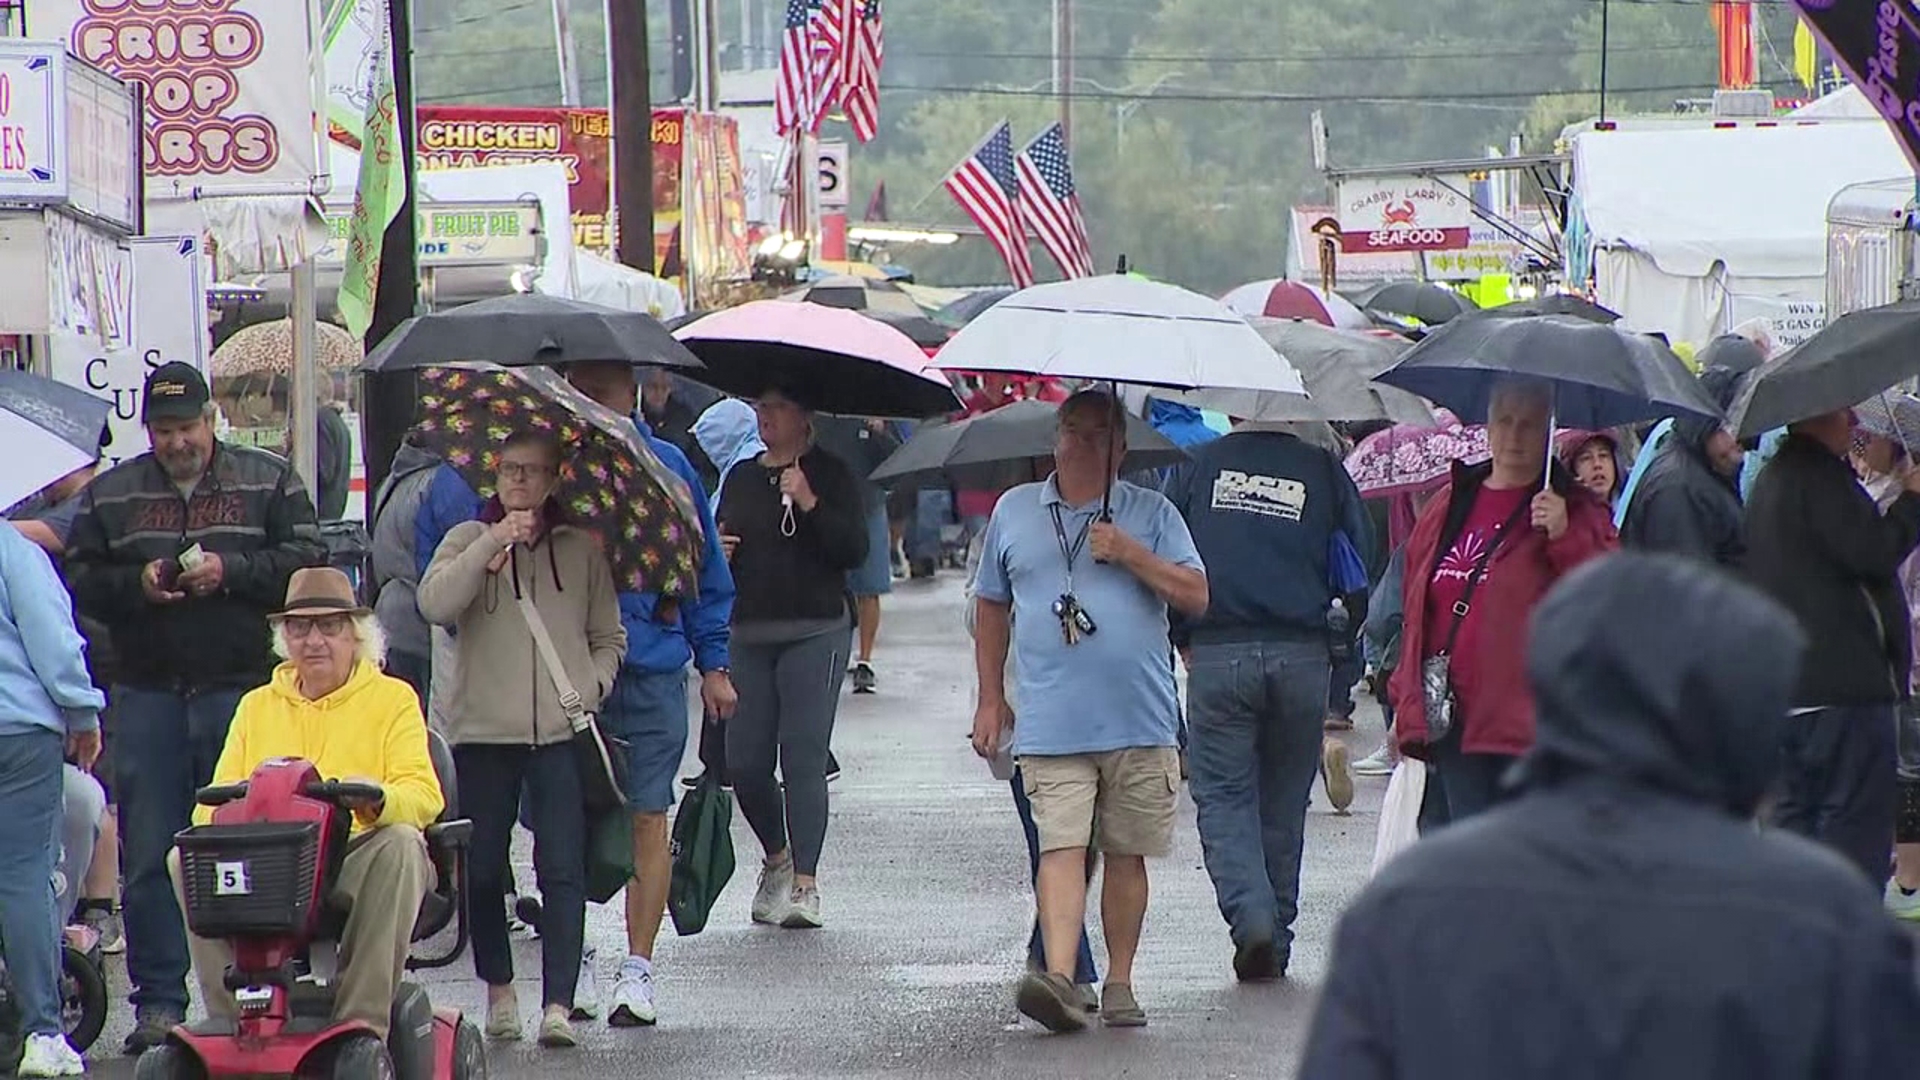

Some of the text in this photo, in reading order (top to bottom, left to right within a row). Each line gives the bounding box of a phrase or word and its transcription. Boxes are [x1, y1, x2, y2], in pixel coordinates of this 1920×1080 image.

[80, 18, 256, 64] FRIED
[144, 72, 232, 115] OP
[424, 123, 558, 149] CHICKEN
[416, 153, 578, 181] N-A-K
[1350, 188, 1457, 213] CRABBY LARRY'S
[432, 212, 519, 237] FRUIT PIE
[1367, 229, 1446, 246] SEAFOOD
[1788, 304, 1814, 314] WIN
[1787, 319, 1811, 330] GAS
[223, 871, 236, 888] 5
